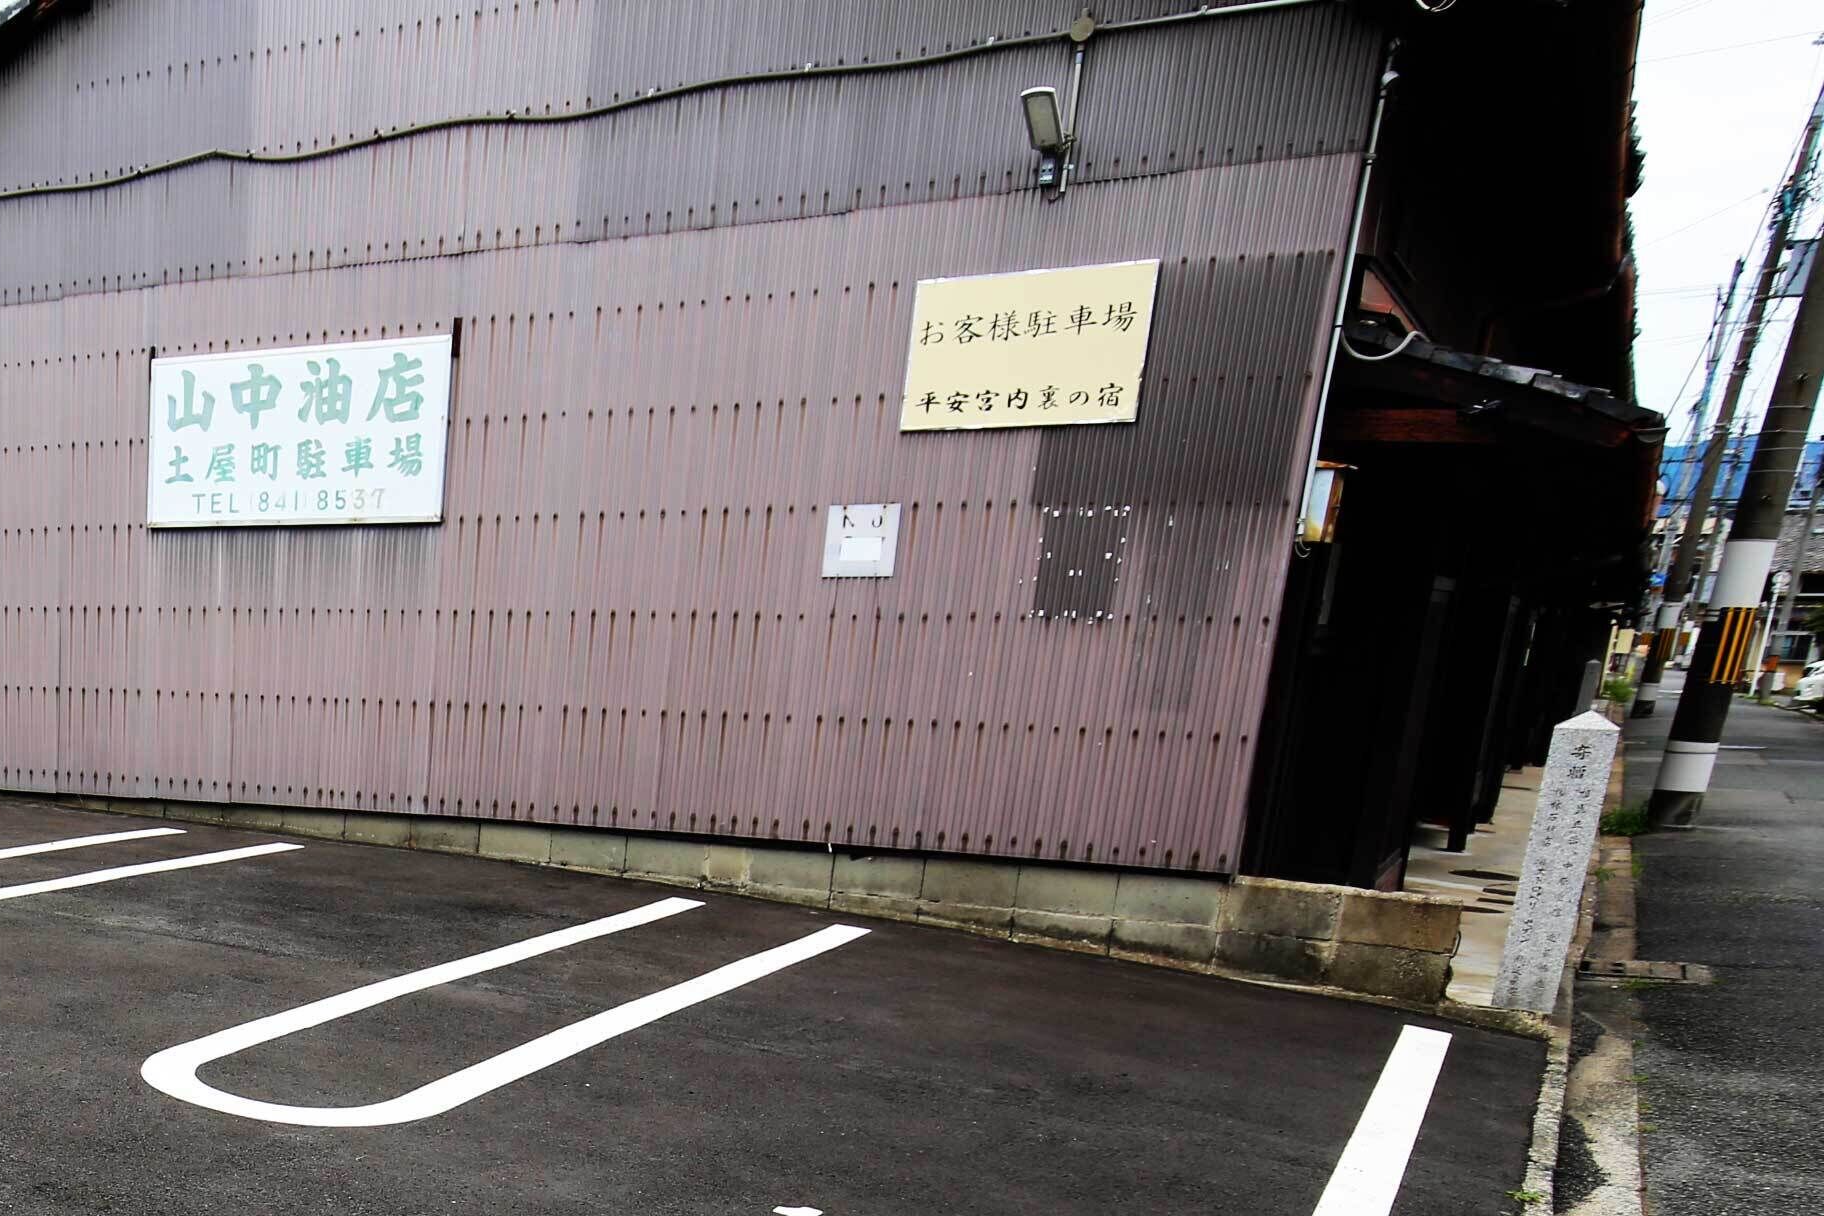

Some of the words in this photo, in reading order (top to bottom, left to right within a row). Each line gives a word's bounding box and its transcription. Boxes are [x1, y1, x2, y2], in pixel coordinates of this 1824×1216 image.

[919, 301, 1138, 346] お客様駐車場
[166, 351, 425, 433] 山中油店
[915, 382, 1124, 414] 平安宮内裏の宿
[164, 431, 424, 485] 土屋町駐車場
[191, 492, 240, 514] TEL
[316, 487, 386, 511] 8537
